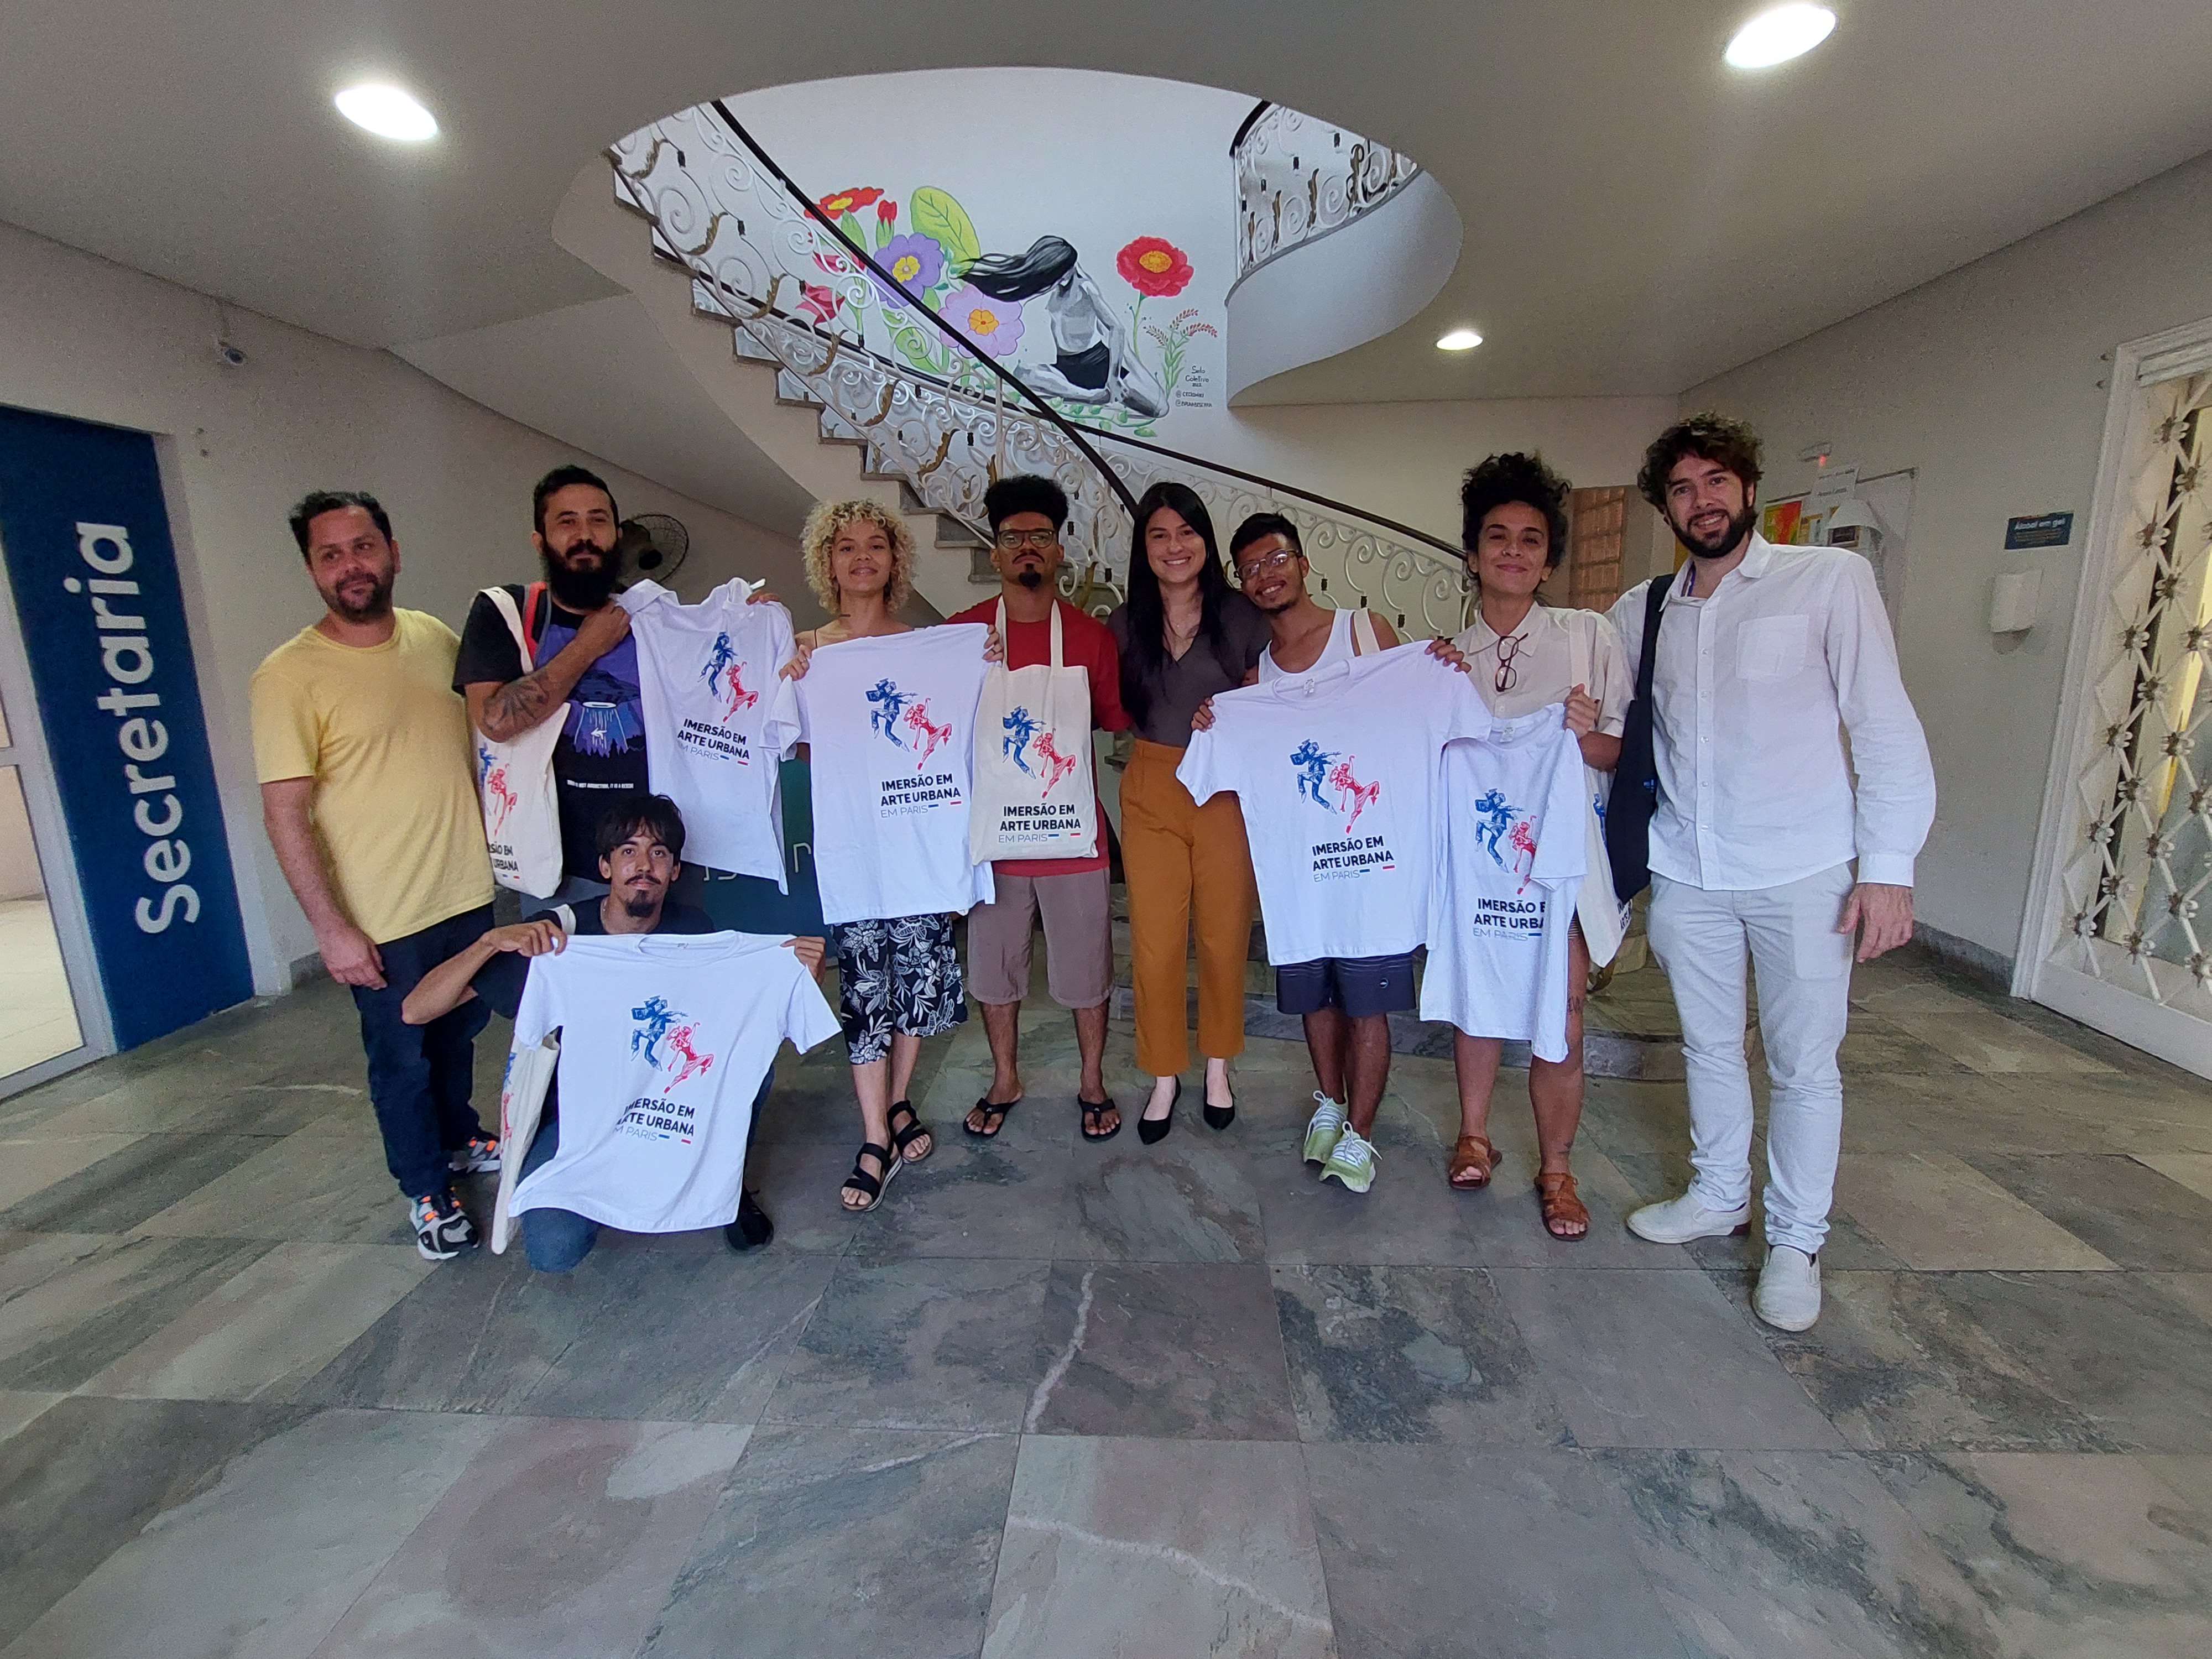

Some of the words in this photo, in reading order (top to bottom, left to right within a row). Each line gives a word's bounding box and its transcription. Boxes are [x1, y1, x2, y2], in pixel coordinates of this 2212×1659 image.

[1191, 366, 1206, 374] Selo
[63, 521, 200, 934] Secretaria
[683, 718, 732, 739] IMERSÃO
[733, 732, 747, 745] EM
[677, 729, 707, 747] ARTE
[708, 738, 750, 760] URBANA
[690, 747, 719, 760] PARIS
[881, 774, 934, 791] IMERSÃO
[936, 773, 953, 785] EM
[881, 793, 911, 807] ARTE
[912, 787, 961, 802] URBANA
[880, 808, 898, 818] EM
[900, 805, 928, 816] PARIS
[1004, 802, 1057, 817] IMERSÃO
[1059, 804, 1075, 815] EM
[1000, 821, 1030, 831] ARTE
[1032, 818, 1081, 830] URBANA
[998, 834, 1015, 843] EM
[1018, 833, 1048, 842] PARIS
[1312, 837, 1363, 856] IMERSÃO
[1365, 836, 1384, 849] EM
[1313, 857, 1342, 872] ARTE
[1342, 850, 1394, 867] URBANA
[1313, 873, 1330, 883] EM
[1332, 869, 1360, 880] PARIS
[1478, 898, 1536, 914] IMERSÃO
[1474, 913, 1507, 928] ARTE
[1473, 927, 1491, 938] EM
[677, 1104, 695, 1119] EM
[646, 1114, 694, 1137] URBANA
[625, 1126, 658, 1141] PARIS
